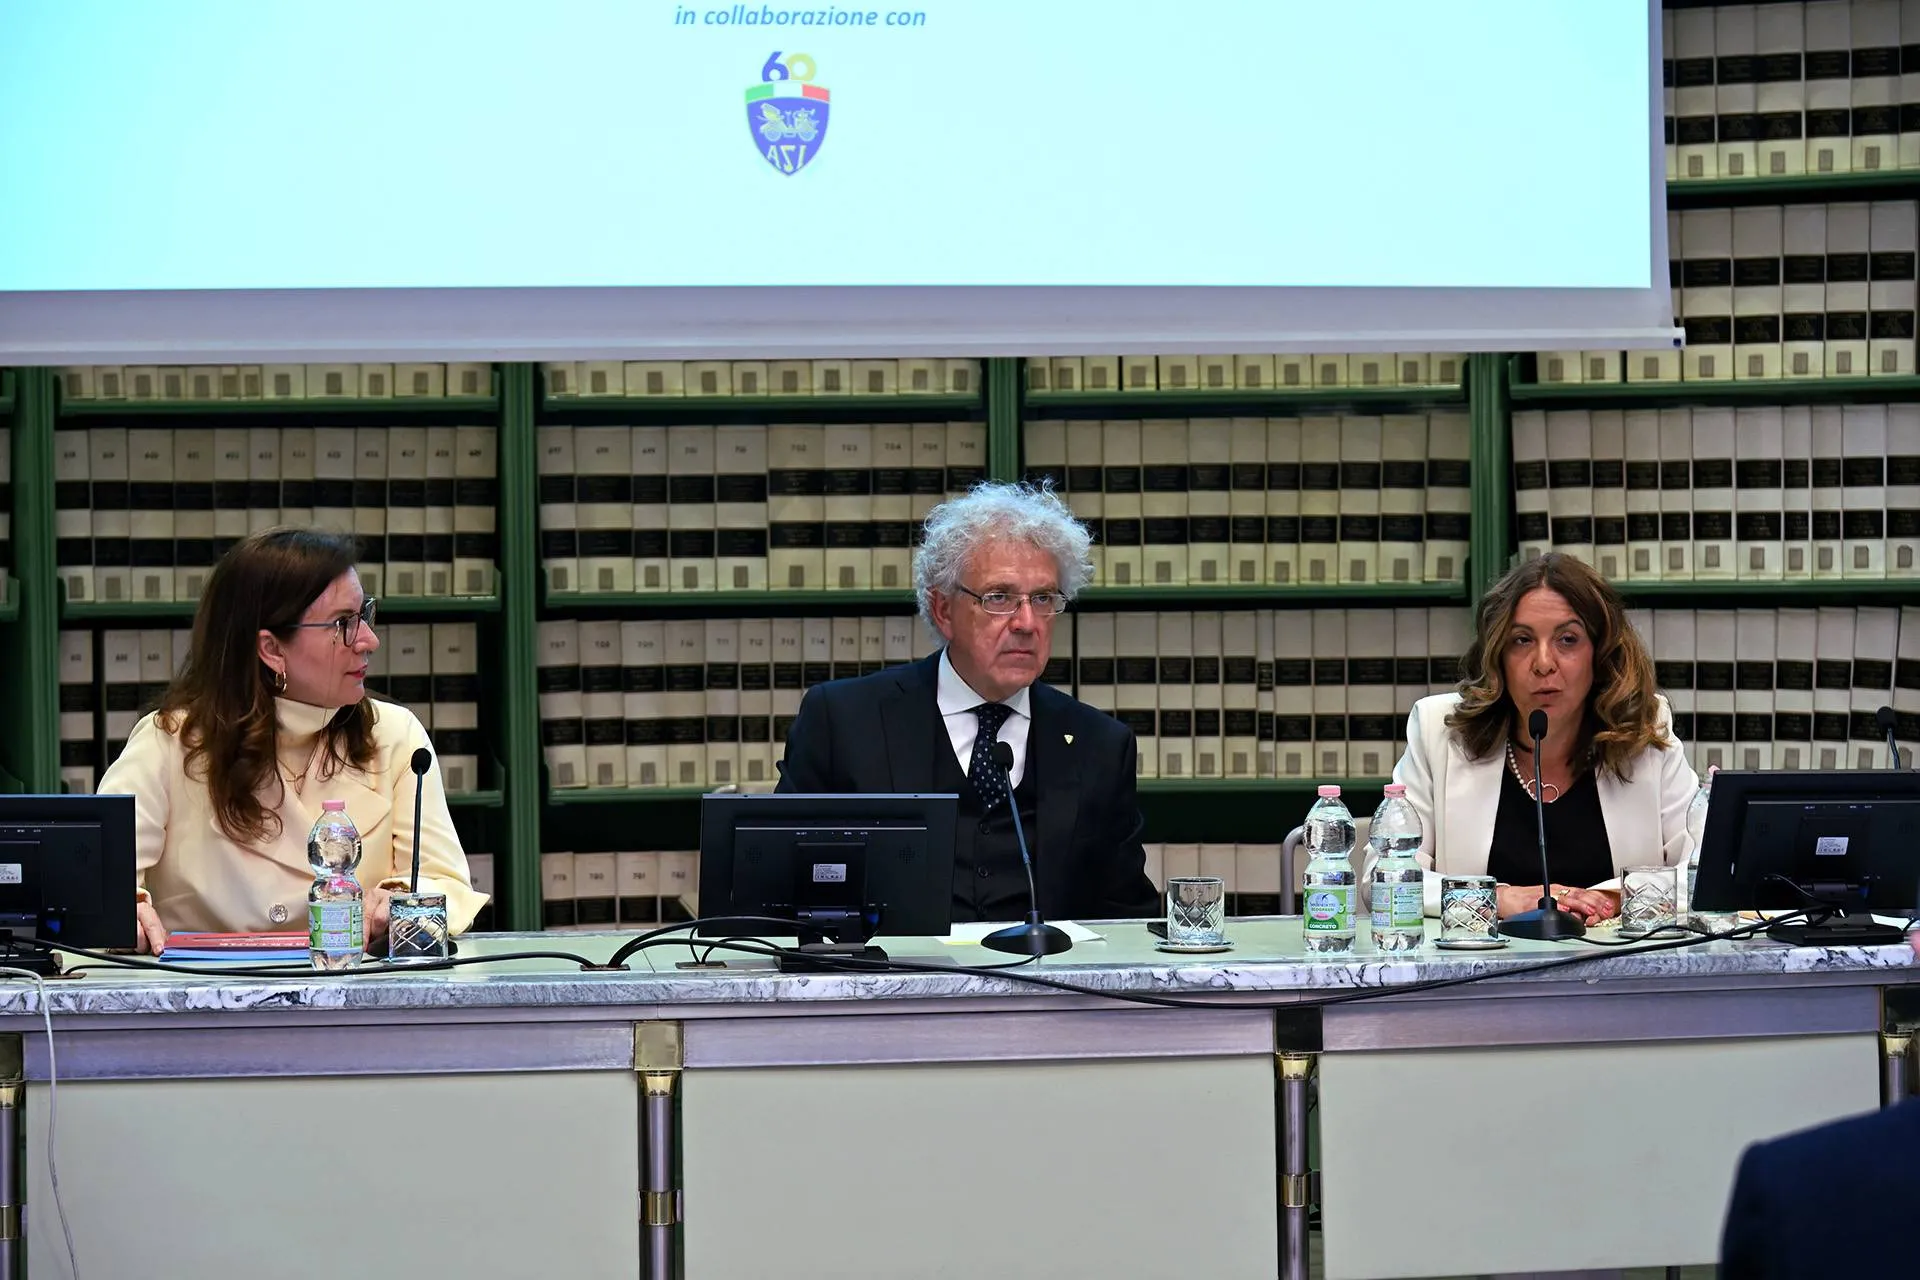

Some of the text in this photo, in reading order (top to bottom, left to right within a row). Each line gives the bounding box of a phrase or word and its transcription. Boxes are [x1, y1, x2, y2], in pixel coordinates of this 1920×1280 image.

[674, 3, 927, 27] in collaborazione con
[761, 50, 817, 82] 60
[766, 144, 807, 172] ASI
